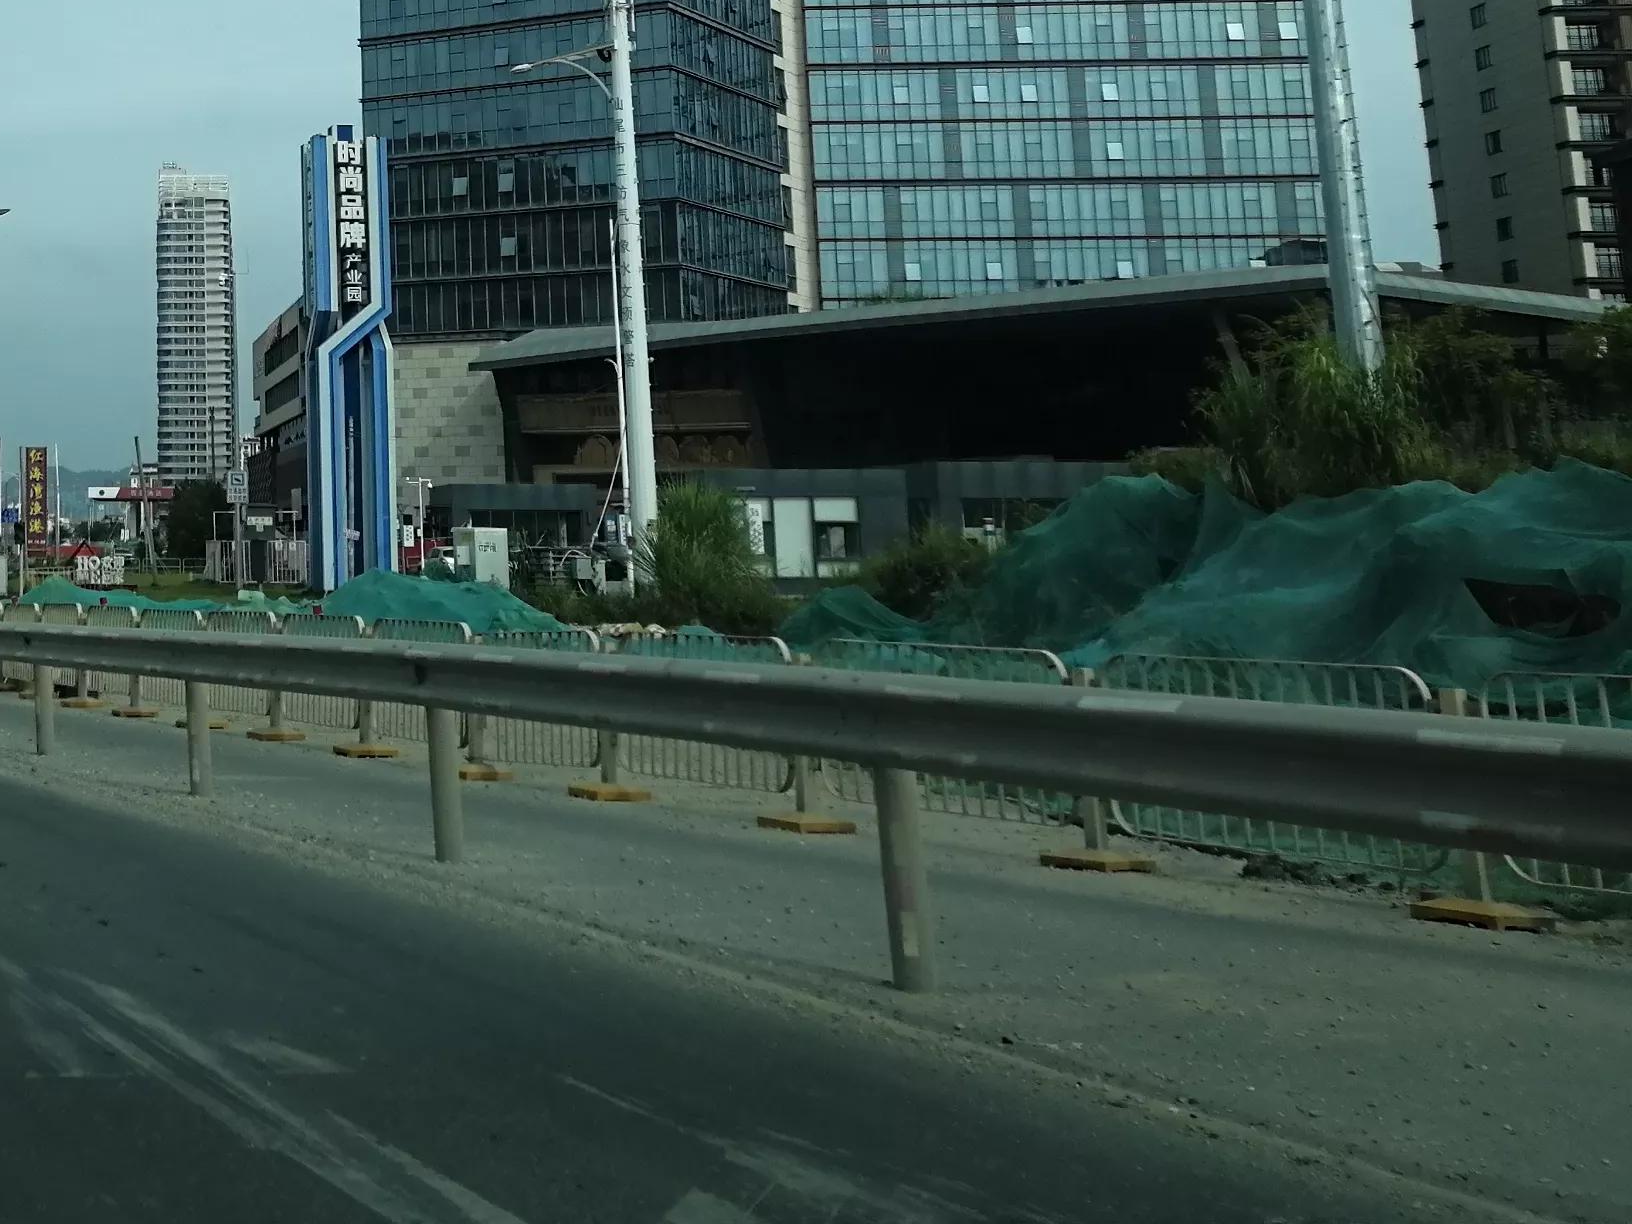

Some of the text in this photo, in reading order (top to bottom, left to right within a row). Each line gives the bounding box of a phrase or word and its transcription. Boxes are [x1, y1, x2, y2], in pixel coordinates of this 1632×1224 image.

[337, 140, 367, 302] 时尚品牌产业园
